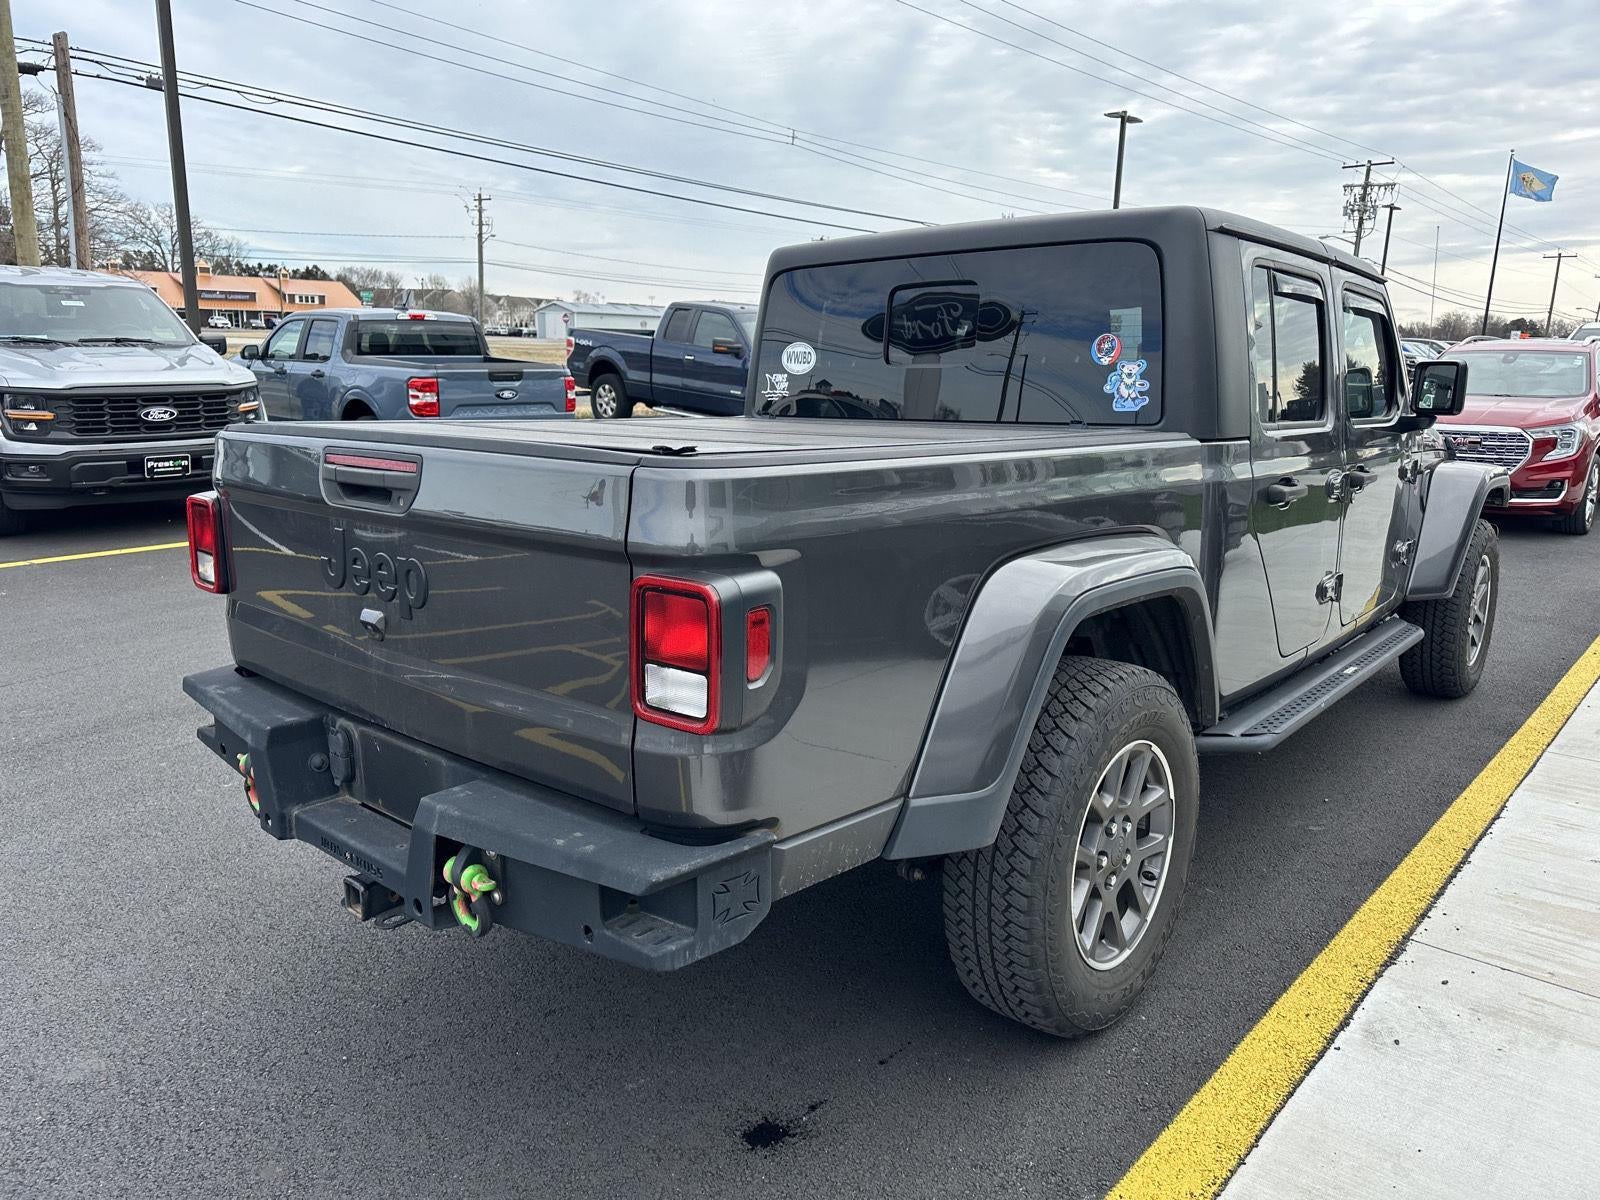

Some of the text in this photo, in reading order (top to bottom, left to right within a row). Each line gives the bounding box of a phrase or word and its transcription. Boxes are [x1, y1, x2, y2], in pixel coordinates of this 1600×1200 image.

[786, 350, 813, 365] WWJBD
[146, 408, 172, 420] Ford
[147, 459, 189, 469] Preston
[320, 527, 429, 621] Jeep
